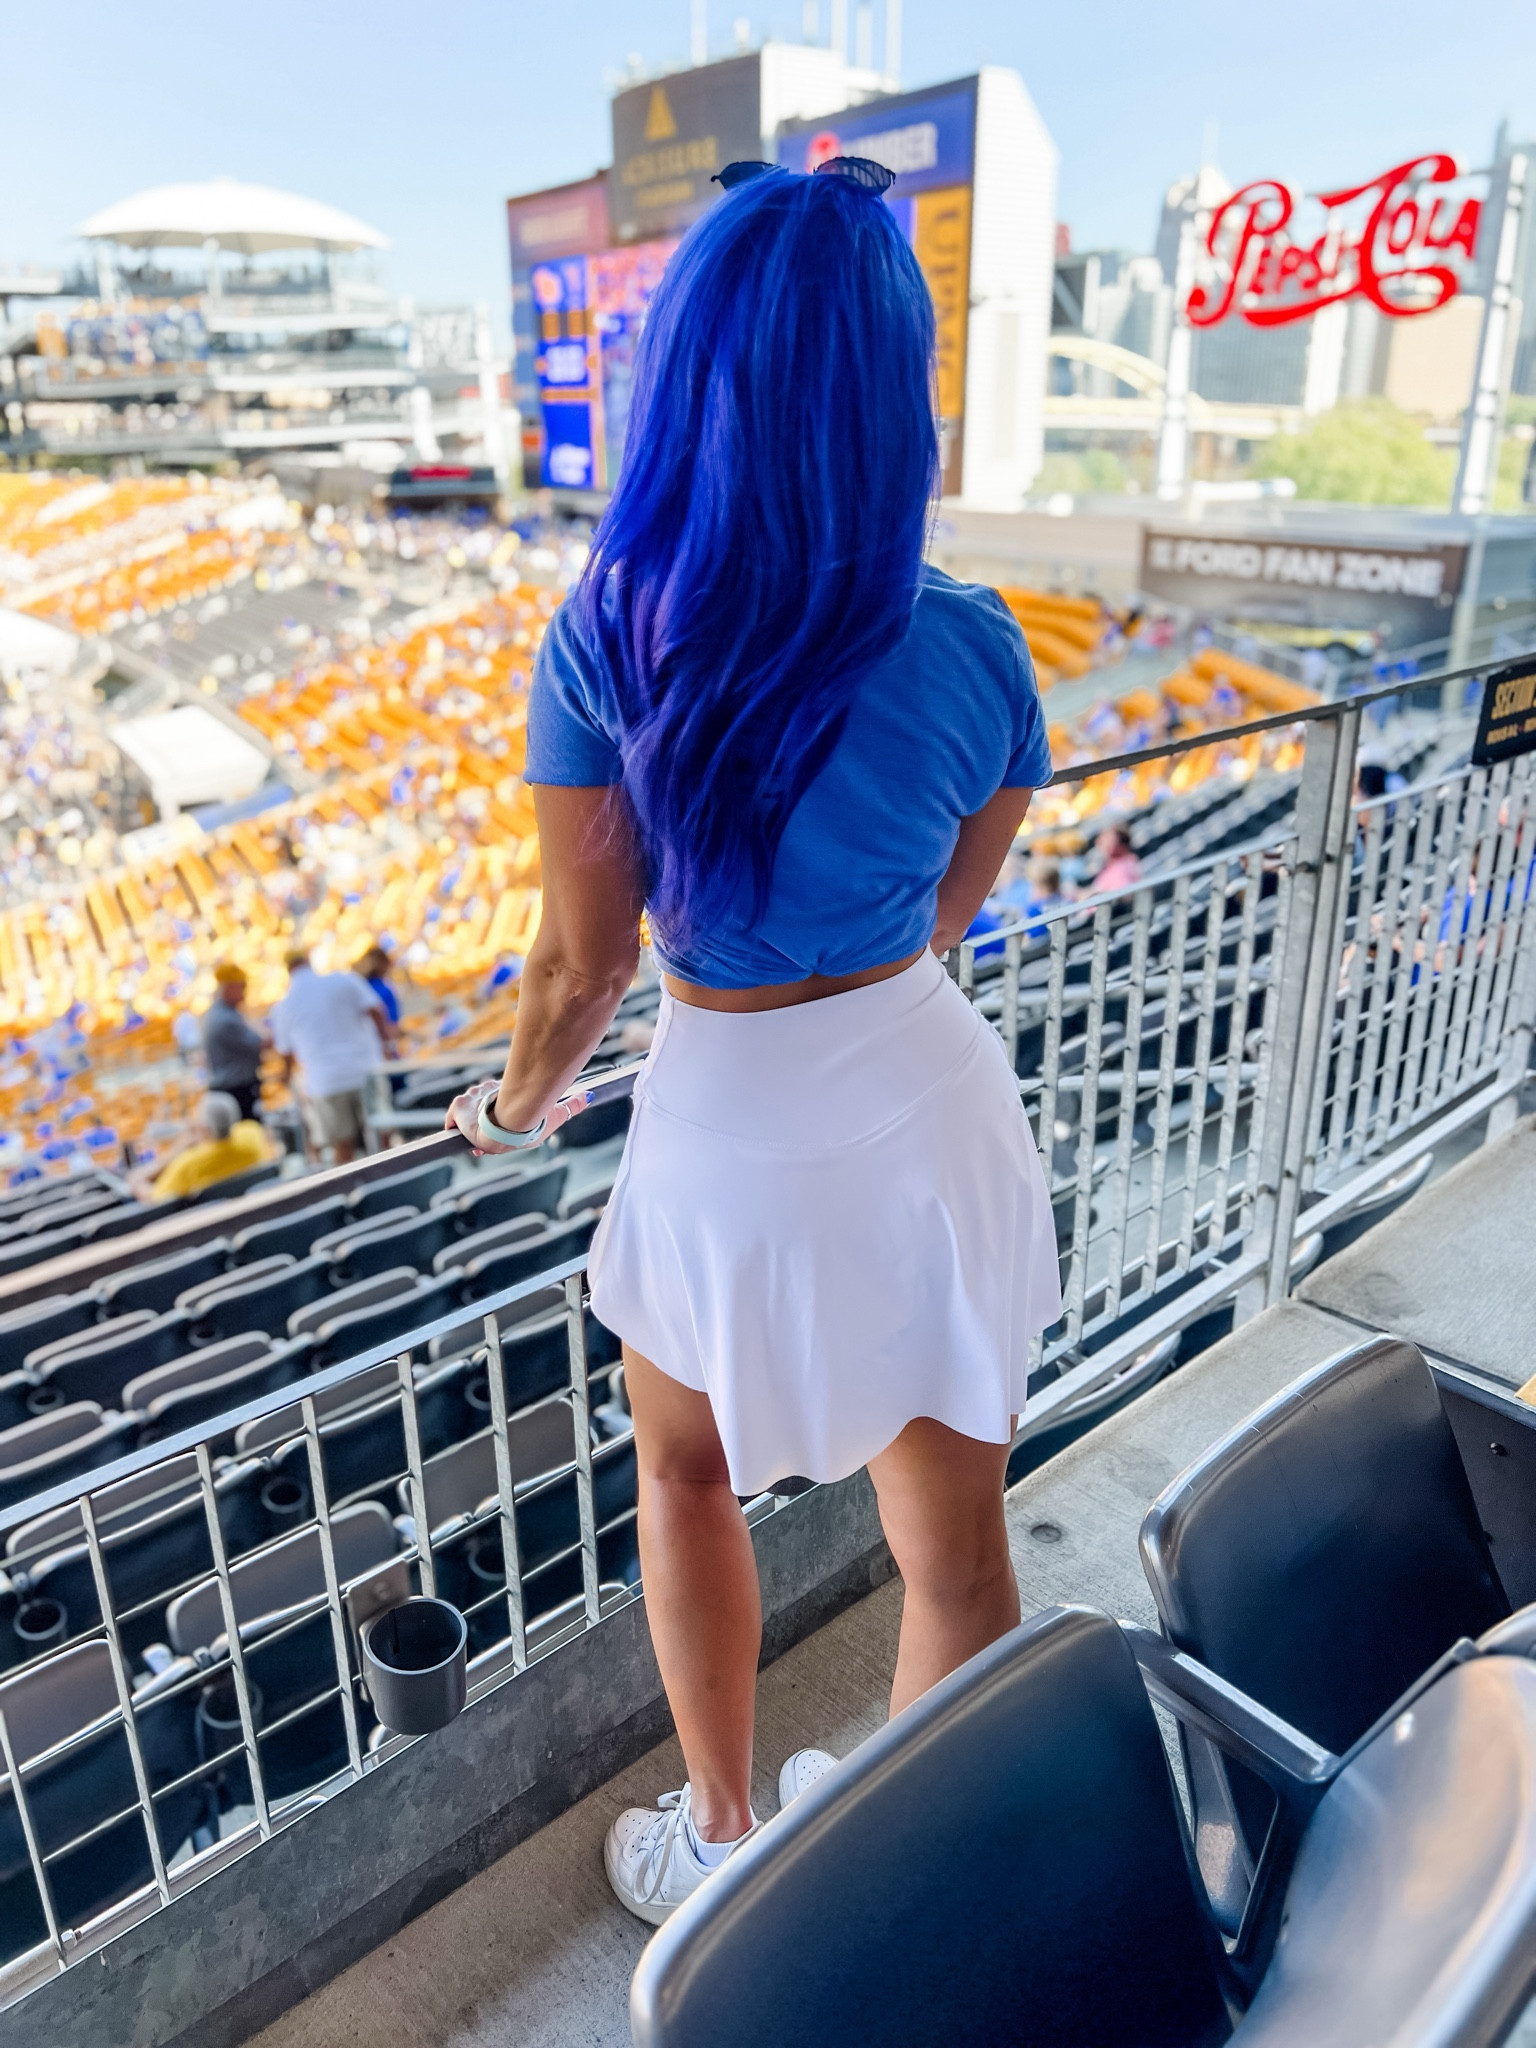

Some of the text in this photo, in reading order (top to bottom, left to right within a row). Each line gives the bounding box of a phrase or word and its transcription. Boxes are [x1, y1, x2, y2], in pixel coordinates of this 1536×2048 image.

[1175, 539, 1262, 579] FORD
[1263, 547, 1335, 586] FAN
[1335, 552, 1444, 598] ZONE
